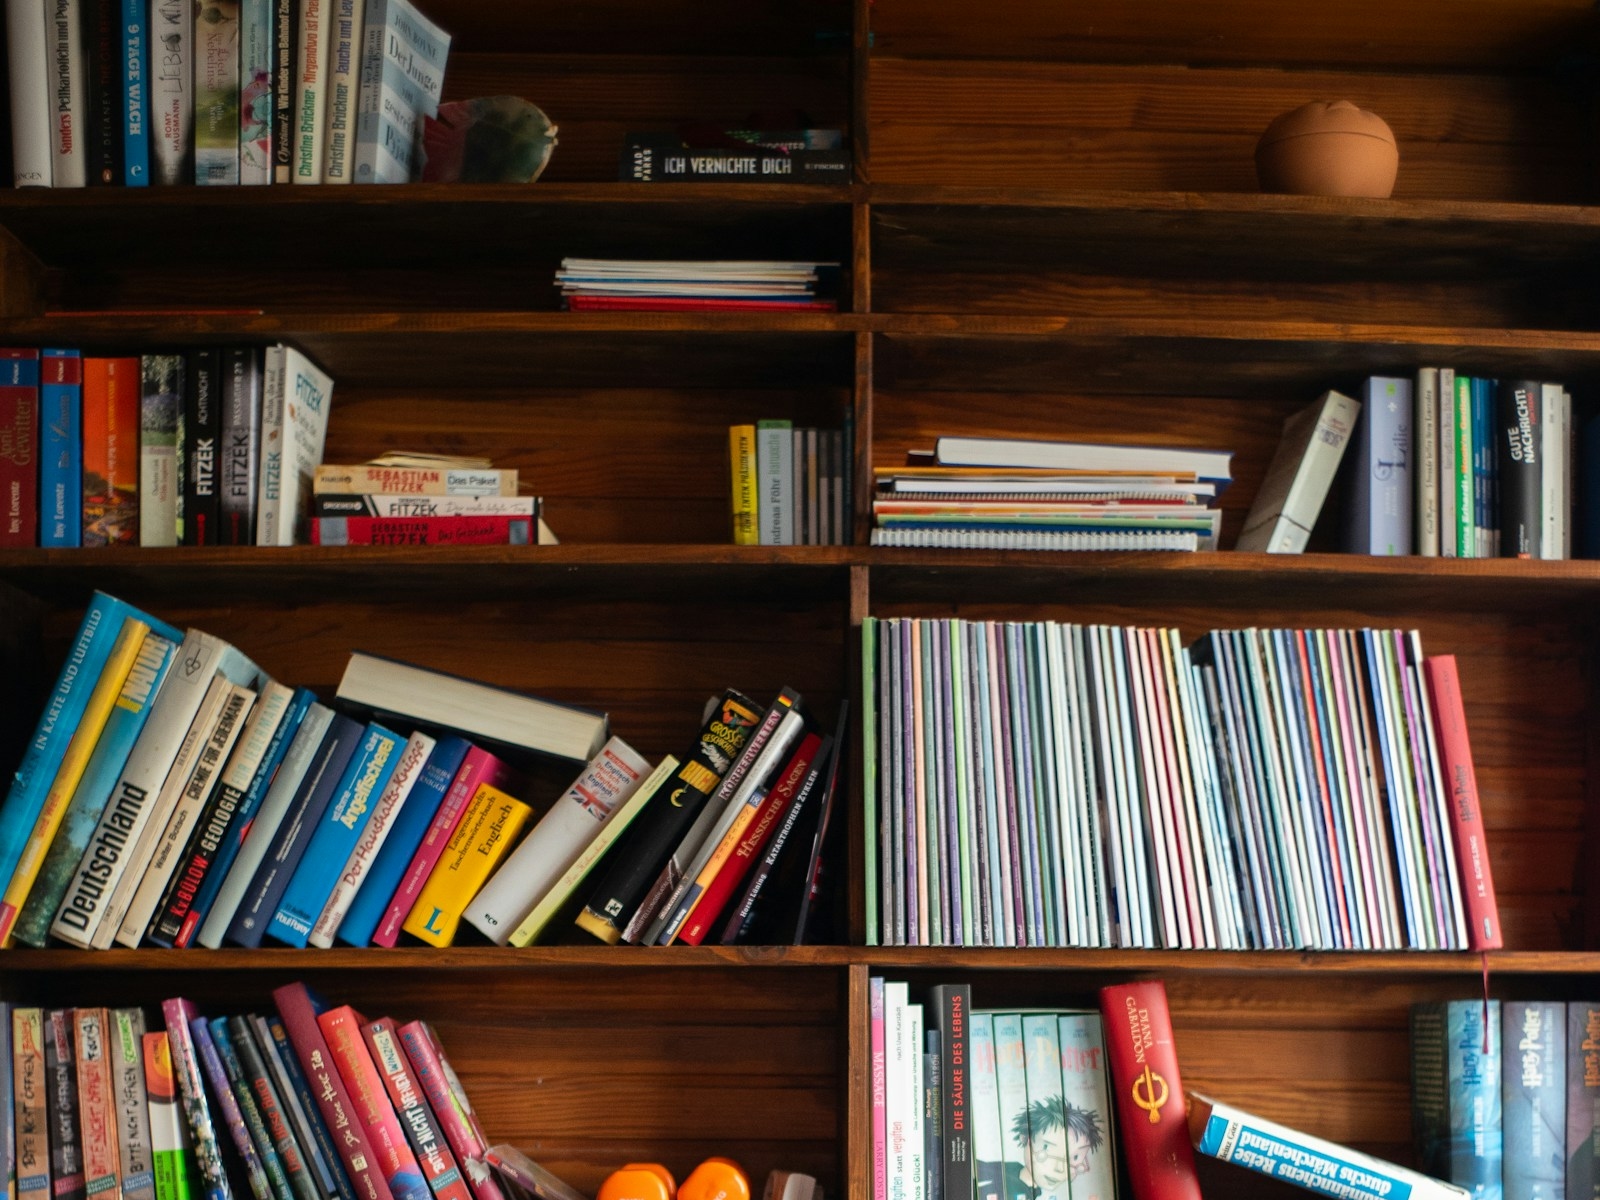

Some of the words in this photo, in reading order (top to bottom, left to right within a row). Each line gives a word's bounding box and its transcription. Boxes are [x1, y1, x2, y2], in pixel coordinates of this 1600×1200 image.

[57, 20, 69, 42] und
[128, 24, 139, 33] 9
[278, 15, 290, 48] Bahnhof
[305, 21, 318, 31] ist
[339, 21, 352, 39] und
[128, 37, 140, 80] TAGE
[158, 33, 183, 93] LIEBES
[280, 50, 290, 66] vom
[303, 33, 318, 83] Nirgendwo
[336, 41, 350, 75] Jauche
[390, 34, 406, 64] Der
[407, 55, 438, 93] Junge
[58, 44, 71, 112] Pellkartoffeln
[278, 68, 289, 94] Kinder
[128, 84, 141, 135] WACH
[278, 94, 288, 109] Wir
[301, 90, 316, 133] Brückner
[331, 83, 348, 130] Brückner
[60, 114, 72, 155] Sanders
[299, 135, 314, 177] Christine
[329, 133, 343, 178] Christine
[664, 157, 686, 174] ICH
[690, 158, 757, 174] VERNICHTE
[762, 158, 792, 174] DICH
[295, 373, 324, 415] FITZEK
[12, 398, 32, 466] Gewitter
[1507, 427, 1524, 461] GUTE
[1514, 389, 1535, 464] NACHRICHT!
[197, 438, 214, 496] FITZEK
[232, 434, 249, 496] FITZEK
[266, 452, 280, 500] FITZEK
[367, 468, 440, 482] SEBASTIAN
[9, 480, 20, 516] Lorentz
[54, 483, 65, 520] Lorentz
[382, 482, 424, 492] FITZEK
[390, 504, 438, 516] FITZEK
[371, 534, 428, 545] FITZEK
[69, 607, 105, 664] LUFTBILD
[56, 662, 80, 694] UND
[40, 694, 67, 733] KARTE
[34, 733, 49, 750] IN
[709, 720, 746, 748] GROSSES
[197, 785, 243, 853] GEOLOGIE
[240, 691, 286, 762] JEDERMANN
[717, 707, 783, 801] KÖRPERWELTEN
[154, 841, 173, 869] Walter
[168, 809, 188, 840] Botsch
[185, 764, 212, 800] CHEMIE
[210, 692, 246, 748] JEDERMANN
[336, 734, 400, 831] Angelfischerei
[587, 774, 614, 798] Englisch
[595, 763, 620, 786] Deutsch
[604, 761, 630, 786] Englisch
[353, 738, 428, 860] Haushalts-Knigge
[735, 795, 784, 859] HESSISCHE
[776, 757, 809, 797] SAGEN
[448, 788, 487, 852] Langenscheidts
[448, 793, 496, 873] Taschenwörterbuch
[477, 802, 515, 857] Englisch
[56, 780, 151, 932] Deutschland
[737, 896, 756, 918] Horst
[747, 871, 770, 899] Lüning
[760, 801, 808, 865] KATASTROPHEN
[794, 768, 822, 802] ZYKLEN
[342, 858, 365, 886] Der
[950, 994, 962, 1038] LEBENS
[1126, 996, 1146, 1064] GABALDON
[1140, 1008, 1153, 1050] DIANA
[1459, 1010, 1480, 1050] Potter
[1518, 1008, 1543, 1050] Potter
[306, 1048, 326, 1072] Ida
[374, 1031, 400, 1072] WINZIG!
[952, 1042, 962, 1064] DES
[1462, 1052, 1482, 1086] Harry
[1522, 1052, 1542, 1088] Harry
[314, 1070, 339, 1103] Hexe
[390, 1071, 418, 1110] ÖFFNEN
[872, 1051, 884, 1108] MASSAGE
[950, 1068, 963, 1106] SÄURE
[328, 1100, 349, 1128] kleine
[404, 1105, 435, 1145] NICHT
[952, 1110, 963, 1130] DIE
[342, 1127, 360, 1147] Die
[876, 1140, 884, 1168] LARRY
[890, 1120, 905, 1153] vergiften
[1236, 1130, 1340, 1178] Märchenland
[422, 1141, 447, 1174] BITTE
[895, 1154, 903, 1172] statt
[912, 1153, 920, 1182] Glück!
[1232, 1146, 1276, 1174] Reise
[876, 1170, 884, 1199] COSTA
[1336, 1165, 1392, 1197] durchs
